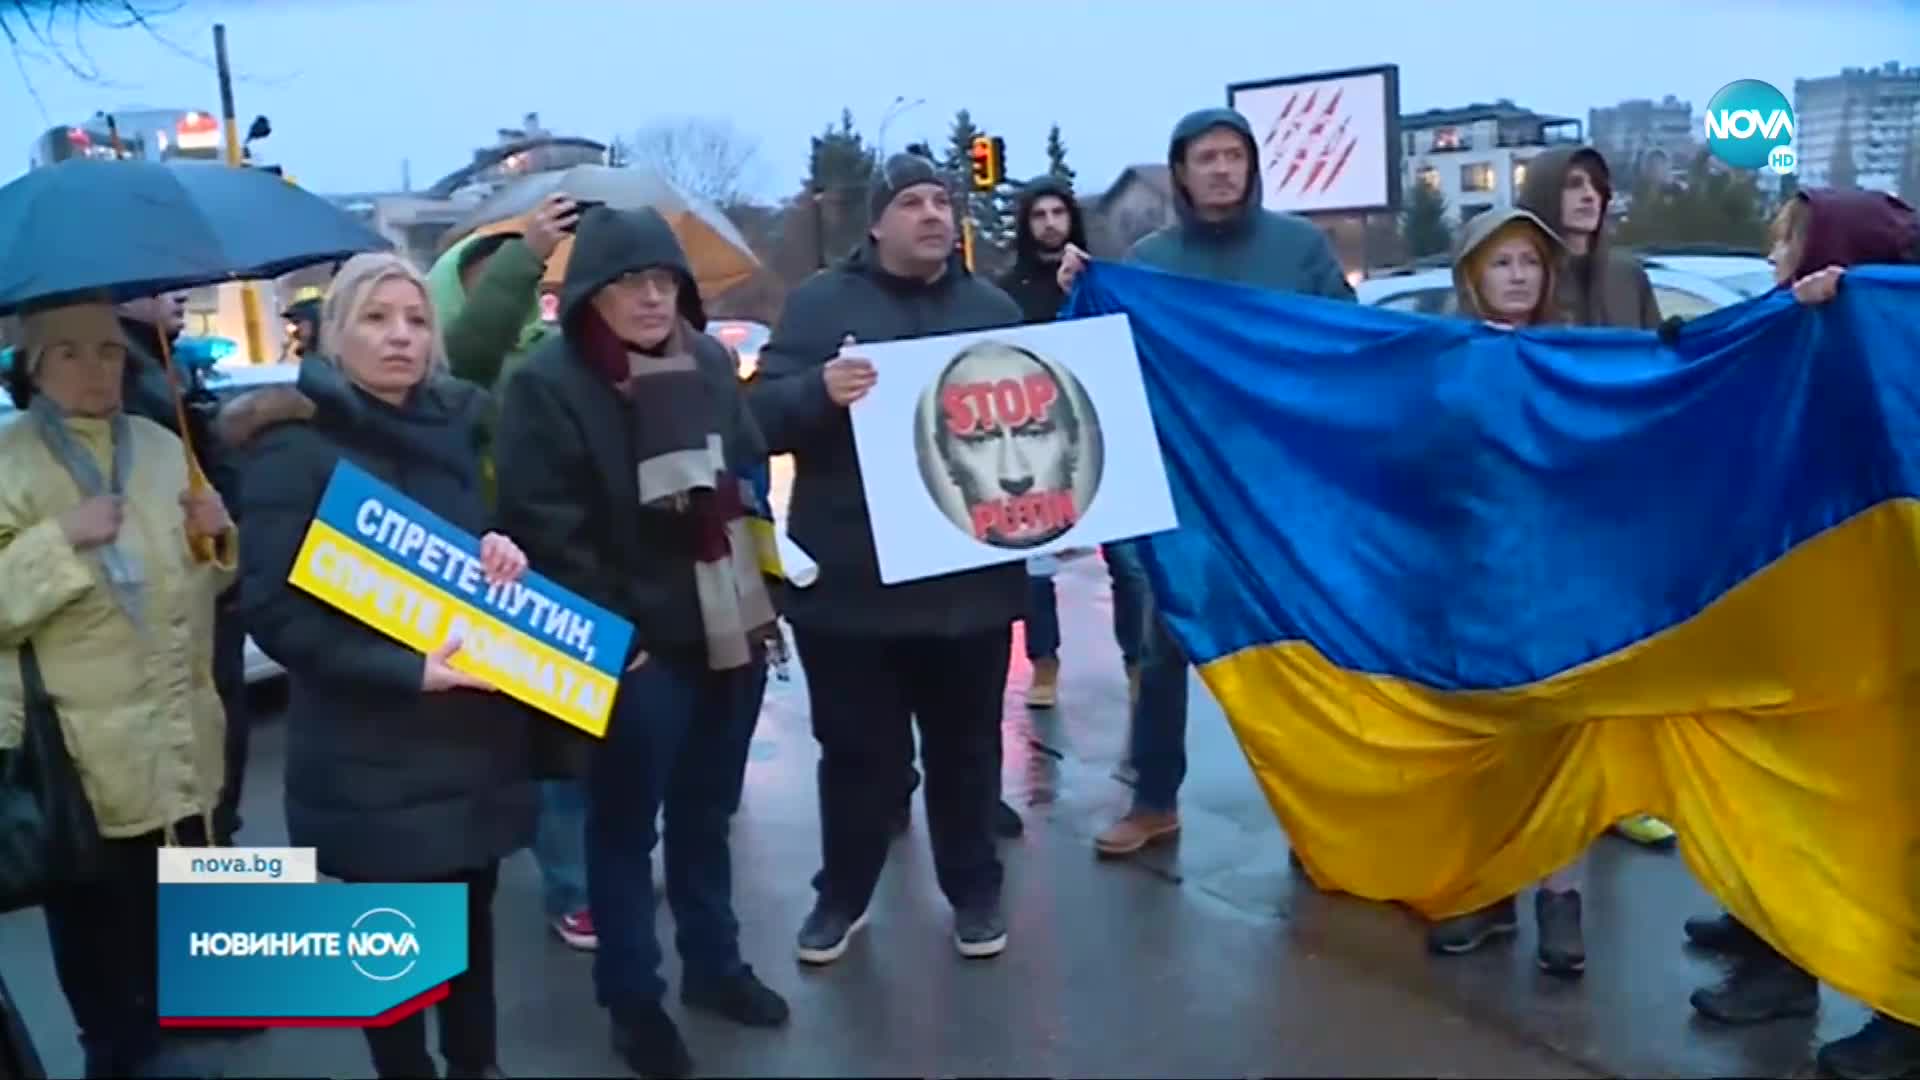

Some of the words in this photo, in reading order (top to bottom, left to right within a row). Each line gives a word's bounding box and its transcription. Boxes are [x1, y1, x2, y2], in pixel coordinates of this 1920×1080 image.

[943, 371, 1058, 434] STOP
[309, 541, 442, 641] СПРЕТЕ
[355, 498, 485, 594] СПРЕТЕ
